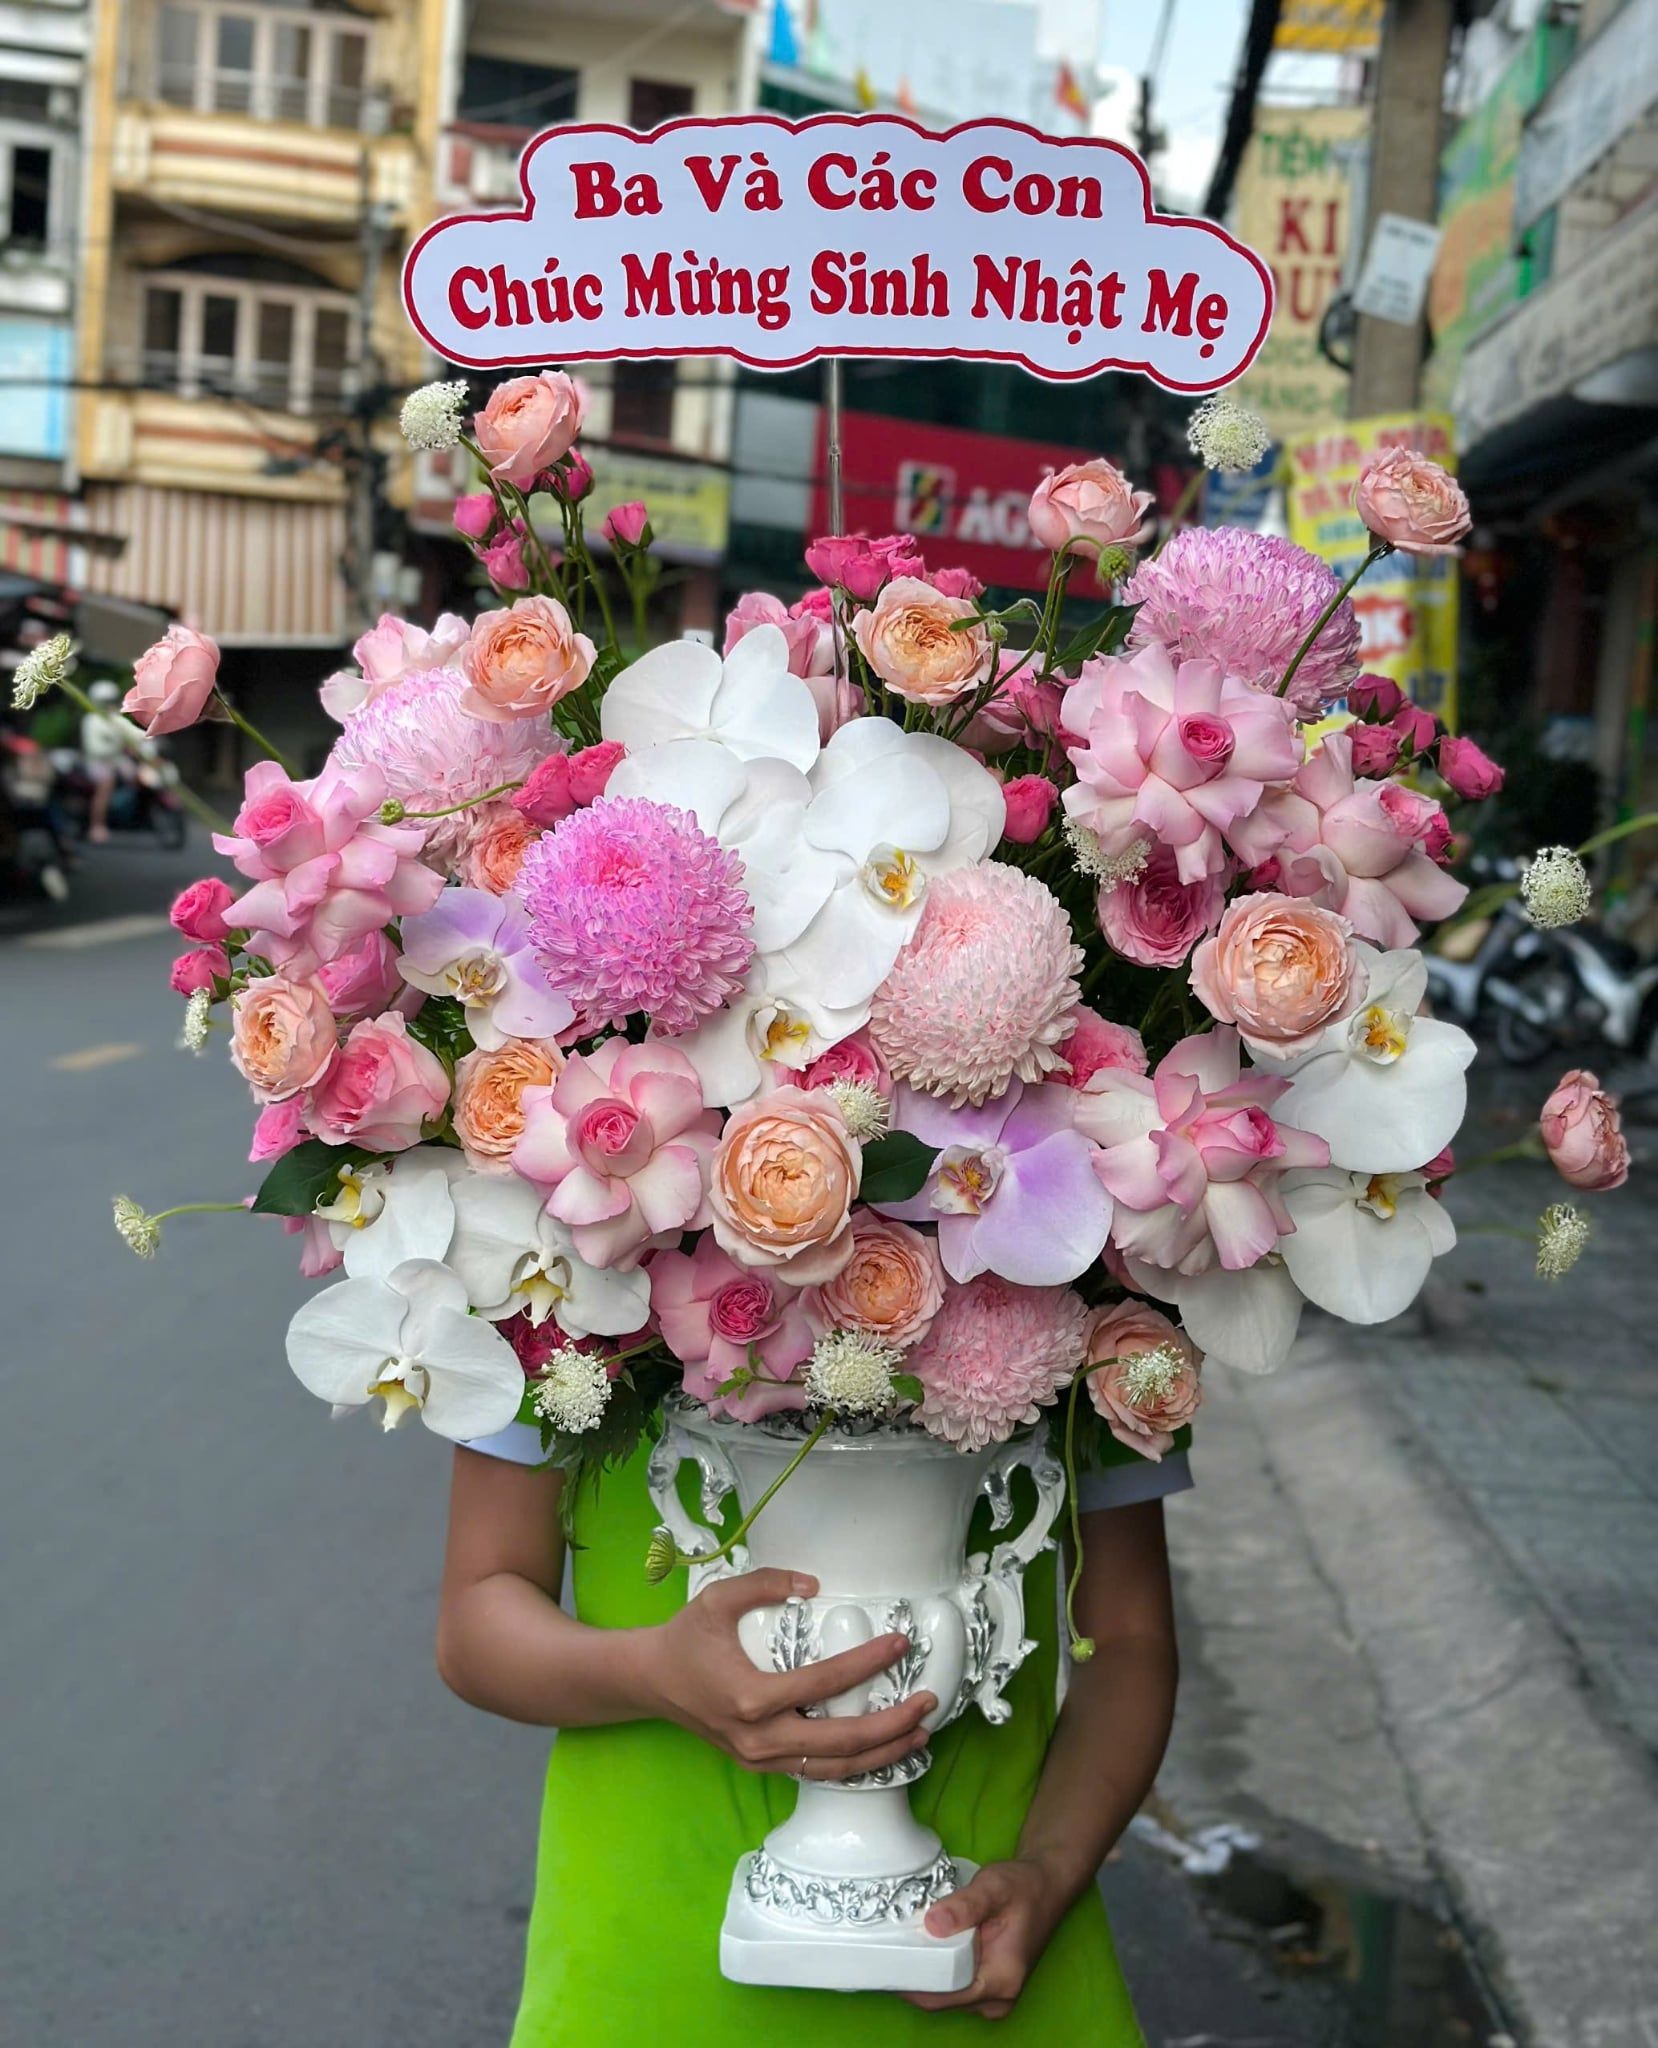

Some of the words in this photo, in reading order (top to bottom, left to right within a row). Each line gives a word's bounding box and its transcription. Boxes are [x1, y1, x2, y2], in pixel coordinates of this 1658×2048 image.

[570, 162, 662, 219] Ba
[684, 151, 782, 212] Và
[808, 152, 936, 213] Các
[963, 156, 1102, 219] Con
[448, 257, 604, 331] Chúc
[622, 249, 792, 331] Mừng
[810, 251, 949, 318] Sinh
[971, 255, 1126, 346] Nhật
[1142, 269, 1229, 359] Mẹ
[956, 486, 1044, 550] AG
